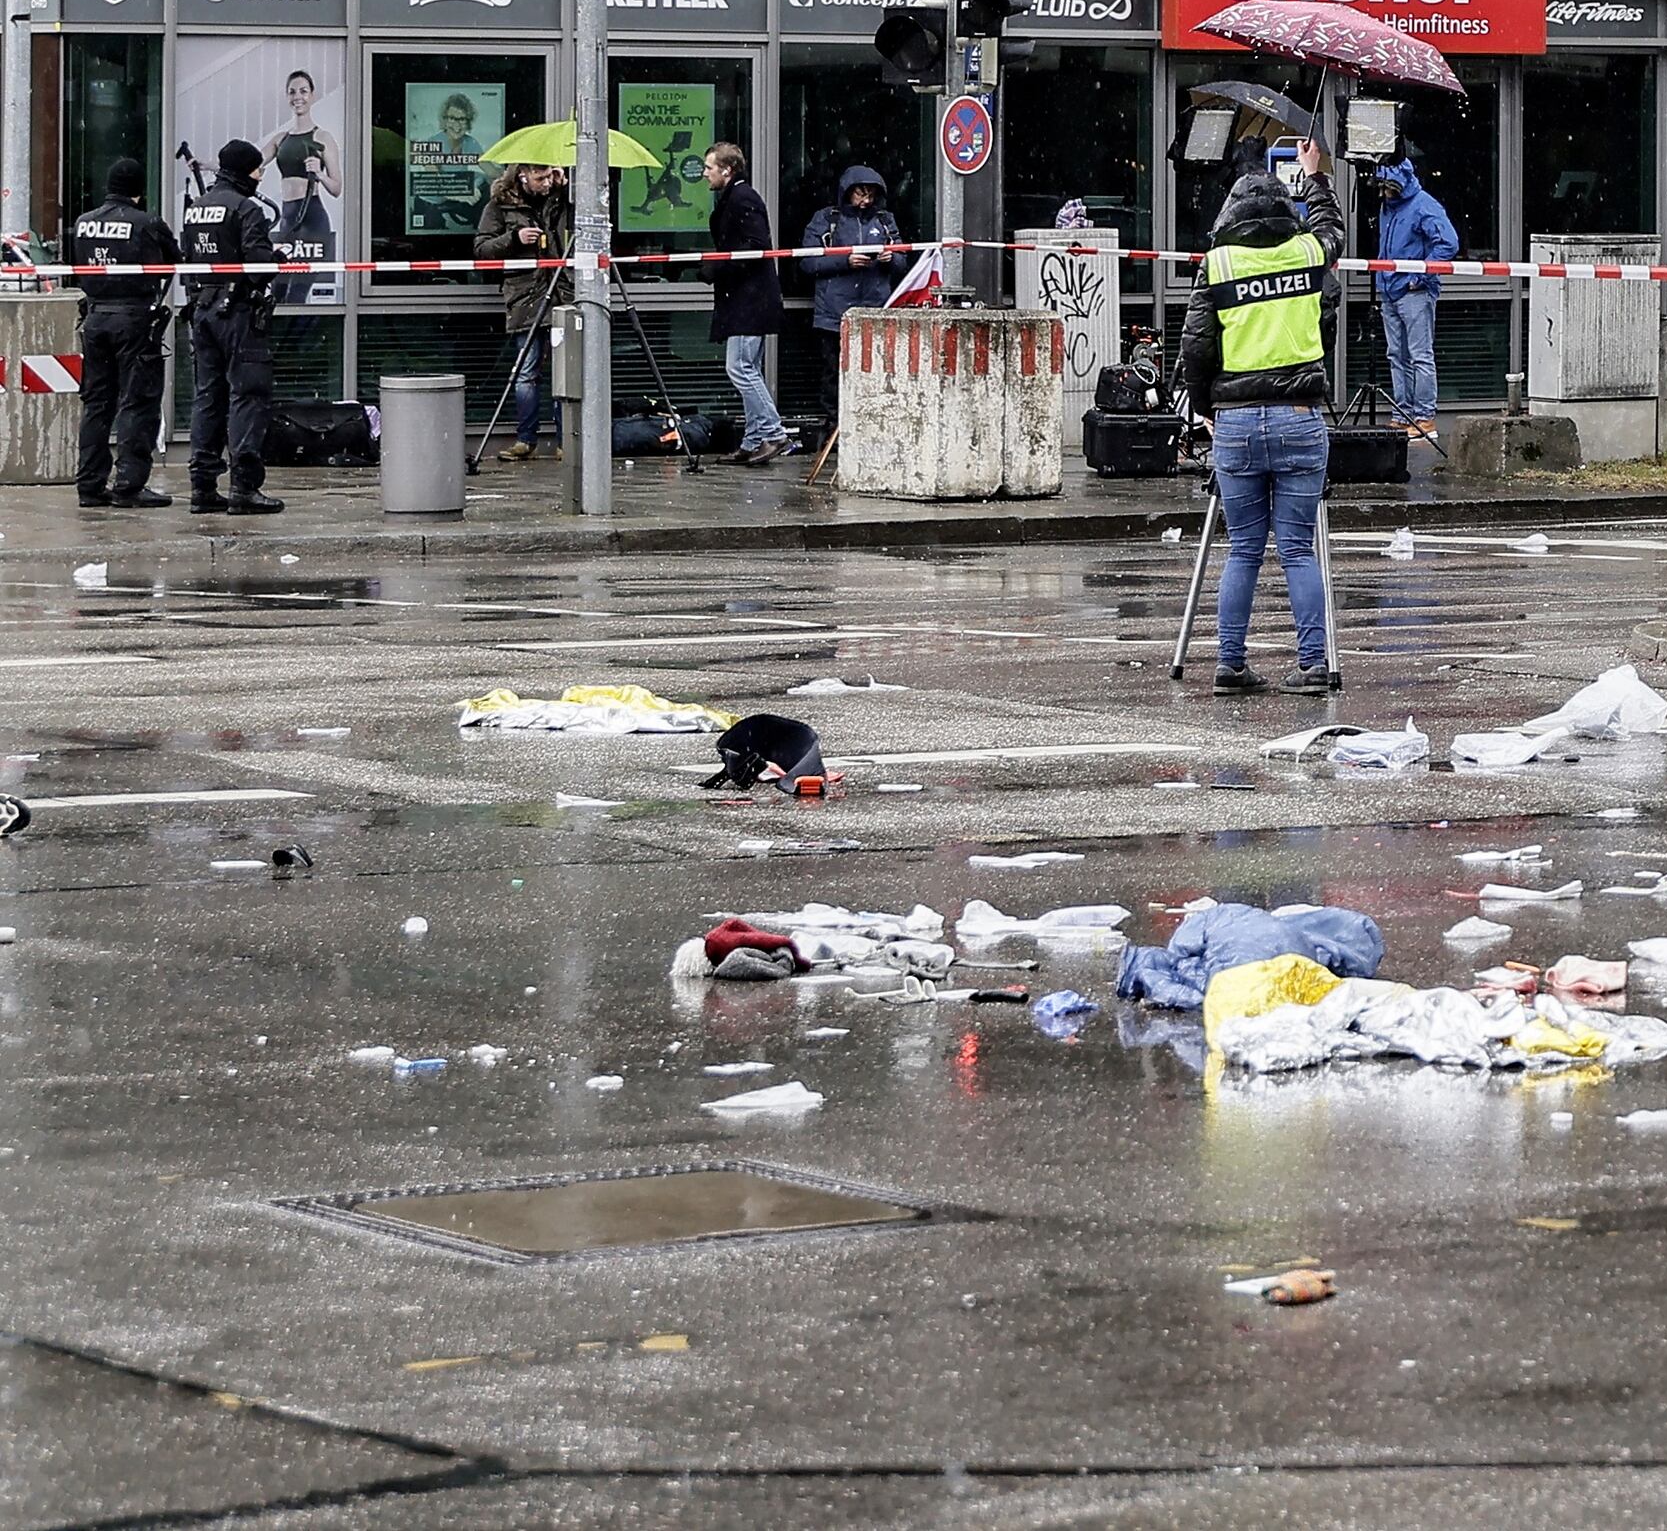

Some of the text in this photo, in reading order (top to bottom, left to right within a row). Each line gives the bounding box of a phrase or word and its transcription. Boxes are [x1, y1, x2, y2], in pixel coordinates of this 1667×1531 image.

[1384, 14, 1489, 35] Heimfitness
[646, 92, 688, 101] PELOTON
[627, 105, 681, 115] JOIN THE
[627, 116, 705, 126] COMMUNITY
[413, 142, 440, 152] FIT IN
[413, 155, 445, 164] JEDEM
[184, 206, 227, 224] POLIZEI
[77, 221, 132, 239] POLIZEI
[198, 233, 210, 243] BY
[95, 247, 108, 259] BY
[1235, 272, 1311, 301] POLIZEI
